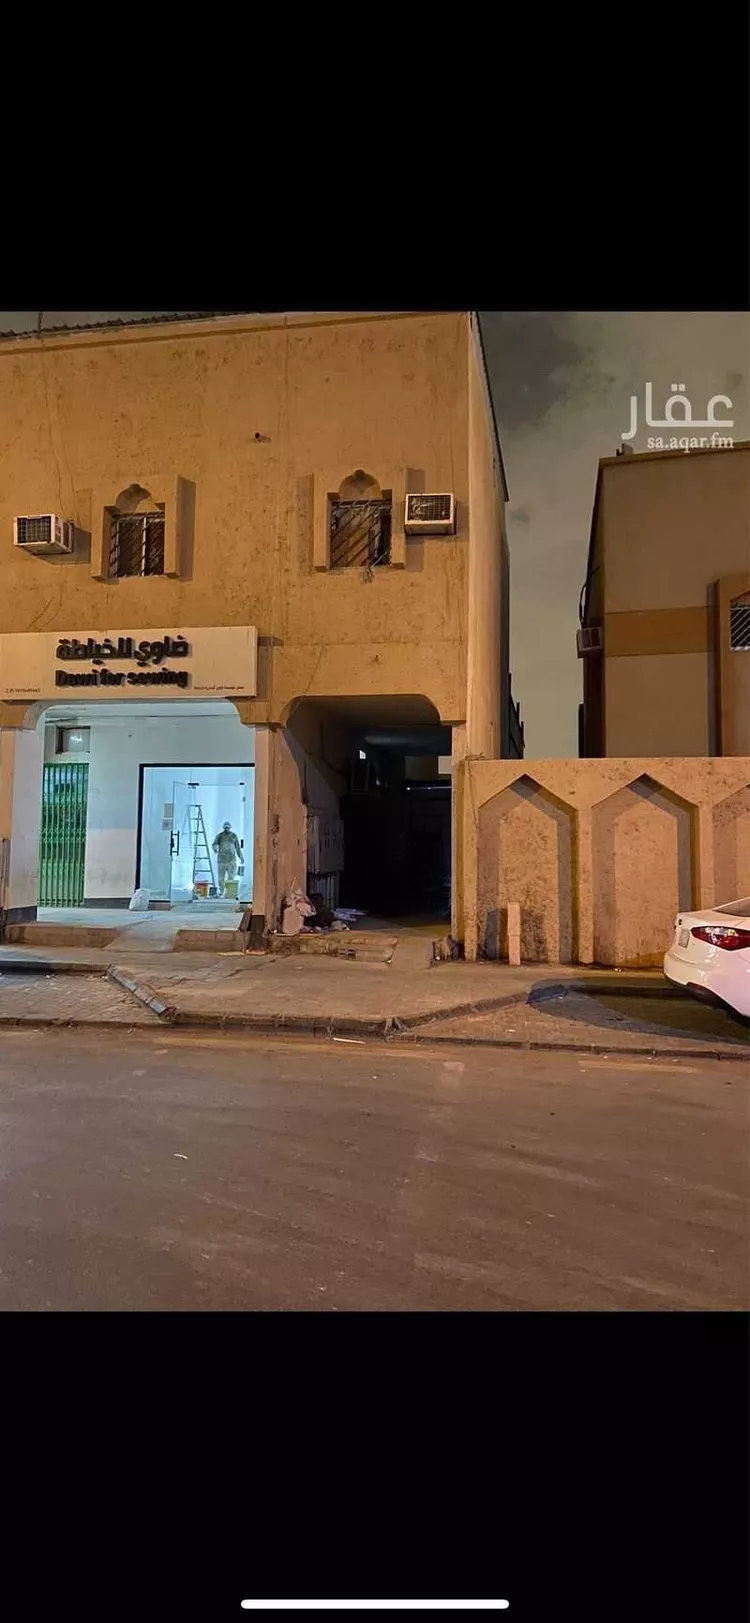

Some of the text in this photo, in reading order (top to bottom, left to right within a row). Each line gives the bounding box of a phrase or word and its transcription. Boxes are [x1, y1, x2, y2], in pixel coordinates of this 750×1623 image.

[56, 635, 189, 667] ضاوي للخياطة
[99, 668, 125, 686] for
[127, 667, 188, 688] sewing
